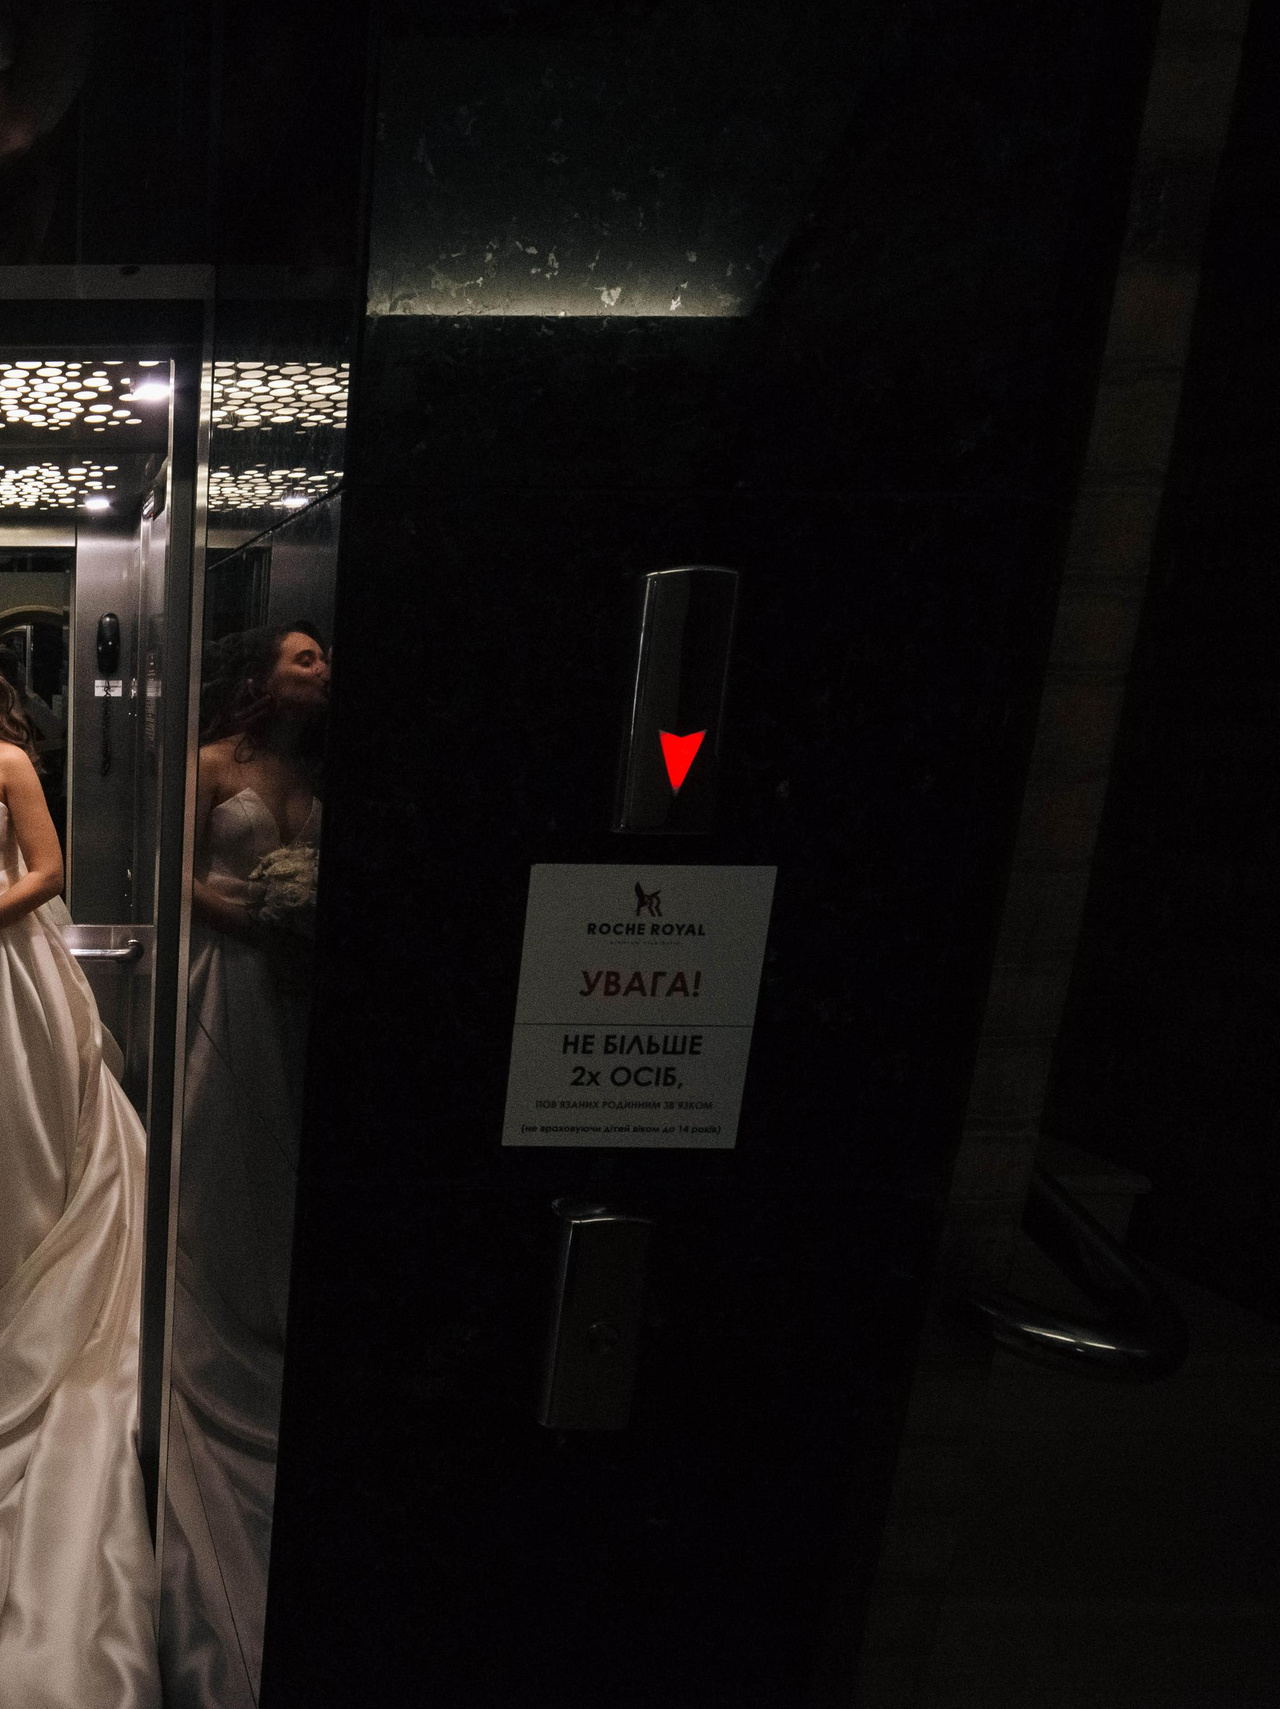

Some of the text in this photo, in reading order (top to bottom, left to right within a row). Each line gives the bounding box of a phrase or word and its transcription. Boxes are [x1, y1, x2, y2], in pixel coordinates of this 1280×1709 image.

[587, 923, 706, 937] ROCHE ROYAL
[579, 970, 702, 997] УВАГА!
[562, 1034, 703, 1055] НЕ БІЛЬШЕ
[610, 1066, 682, 1090] ОСІБ,
[601, 1101, 661, 1110] РОДИННИМ
[521, 1124, 722, 1135] (не враховуючи дітей віком до 14 років)
